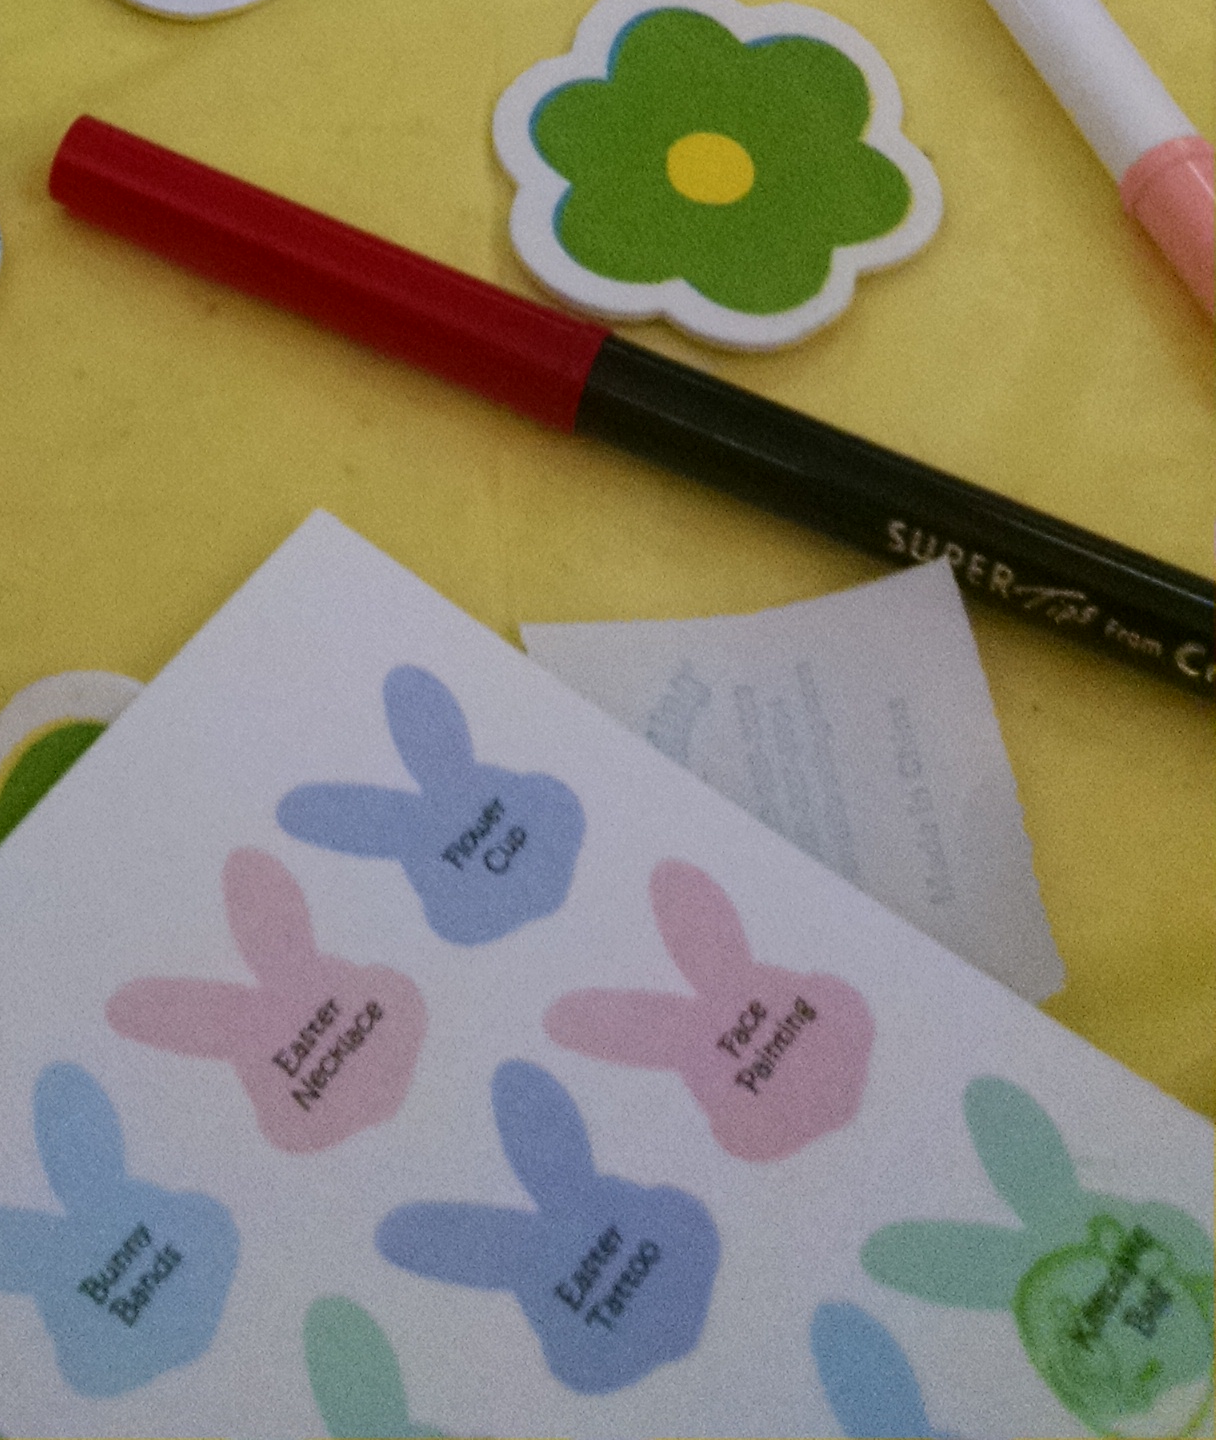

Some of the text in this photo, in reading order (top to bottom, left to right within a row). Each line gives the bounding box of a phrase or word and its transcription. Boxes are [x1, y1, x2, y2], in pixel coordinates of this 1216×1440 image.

[883, 519, 1016, 598] SUPER
[439, 794, 510, 874] Flower
[482, 822, 530, 876] Cup
[272, 993, 345, 1076] Easter
[291, 998, 387, 1112] Necklace
[717, 997, 772, 1058] Face
[734, 995, 821, 1097] Painting
[77, 1217, 158, 1308] Bunny
[111, 1242, 186, 1327] Bands
[553, 1224, 632, 1313] Easter
[586, 1238, 669, 1335] Tattoo
